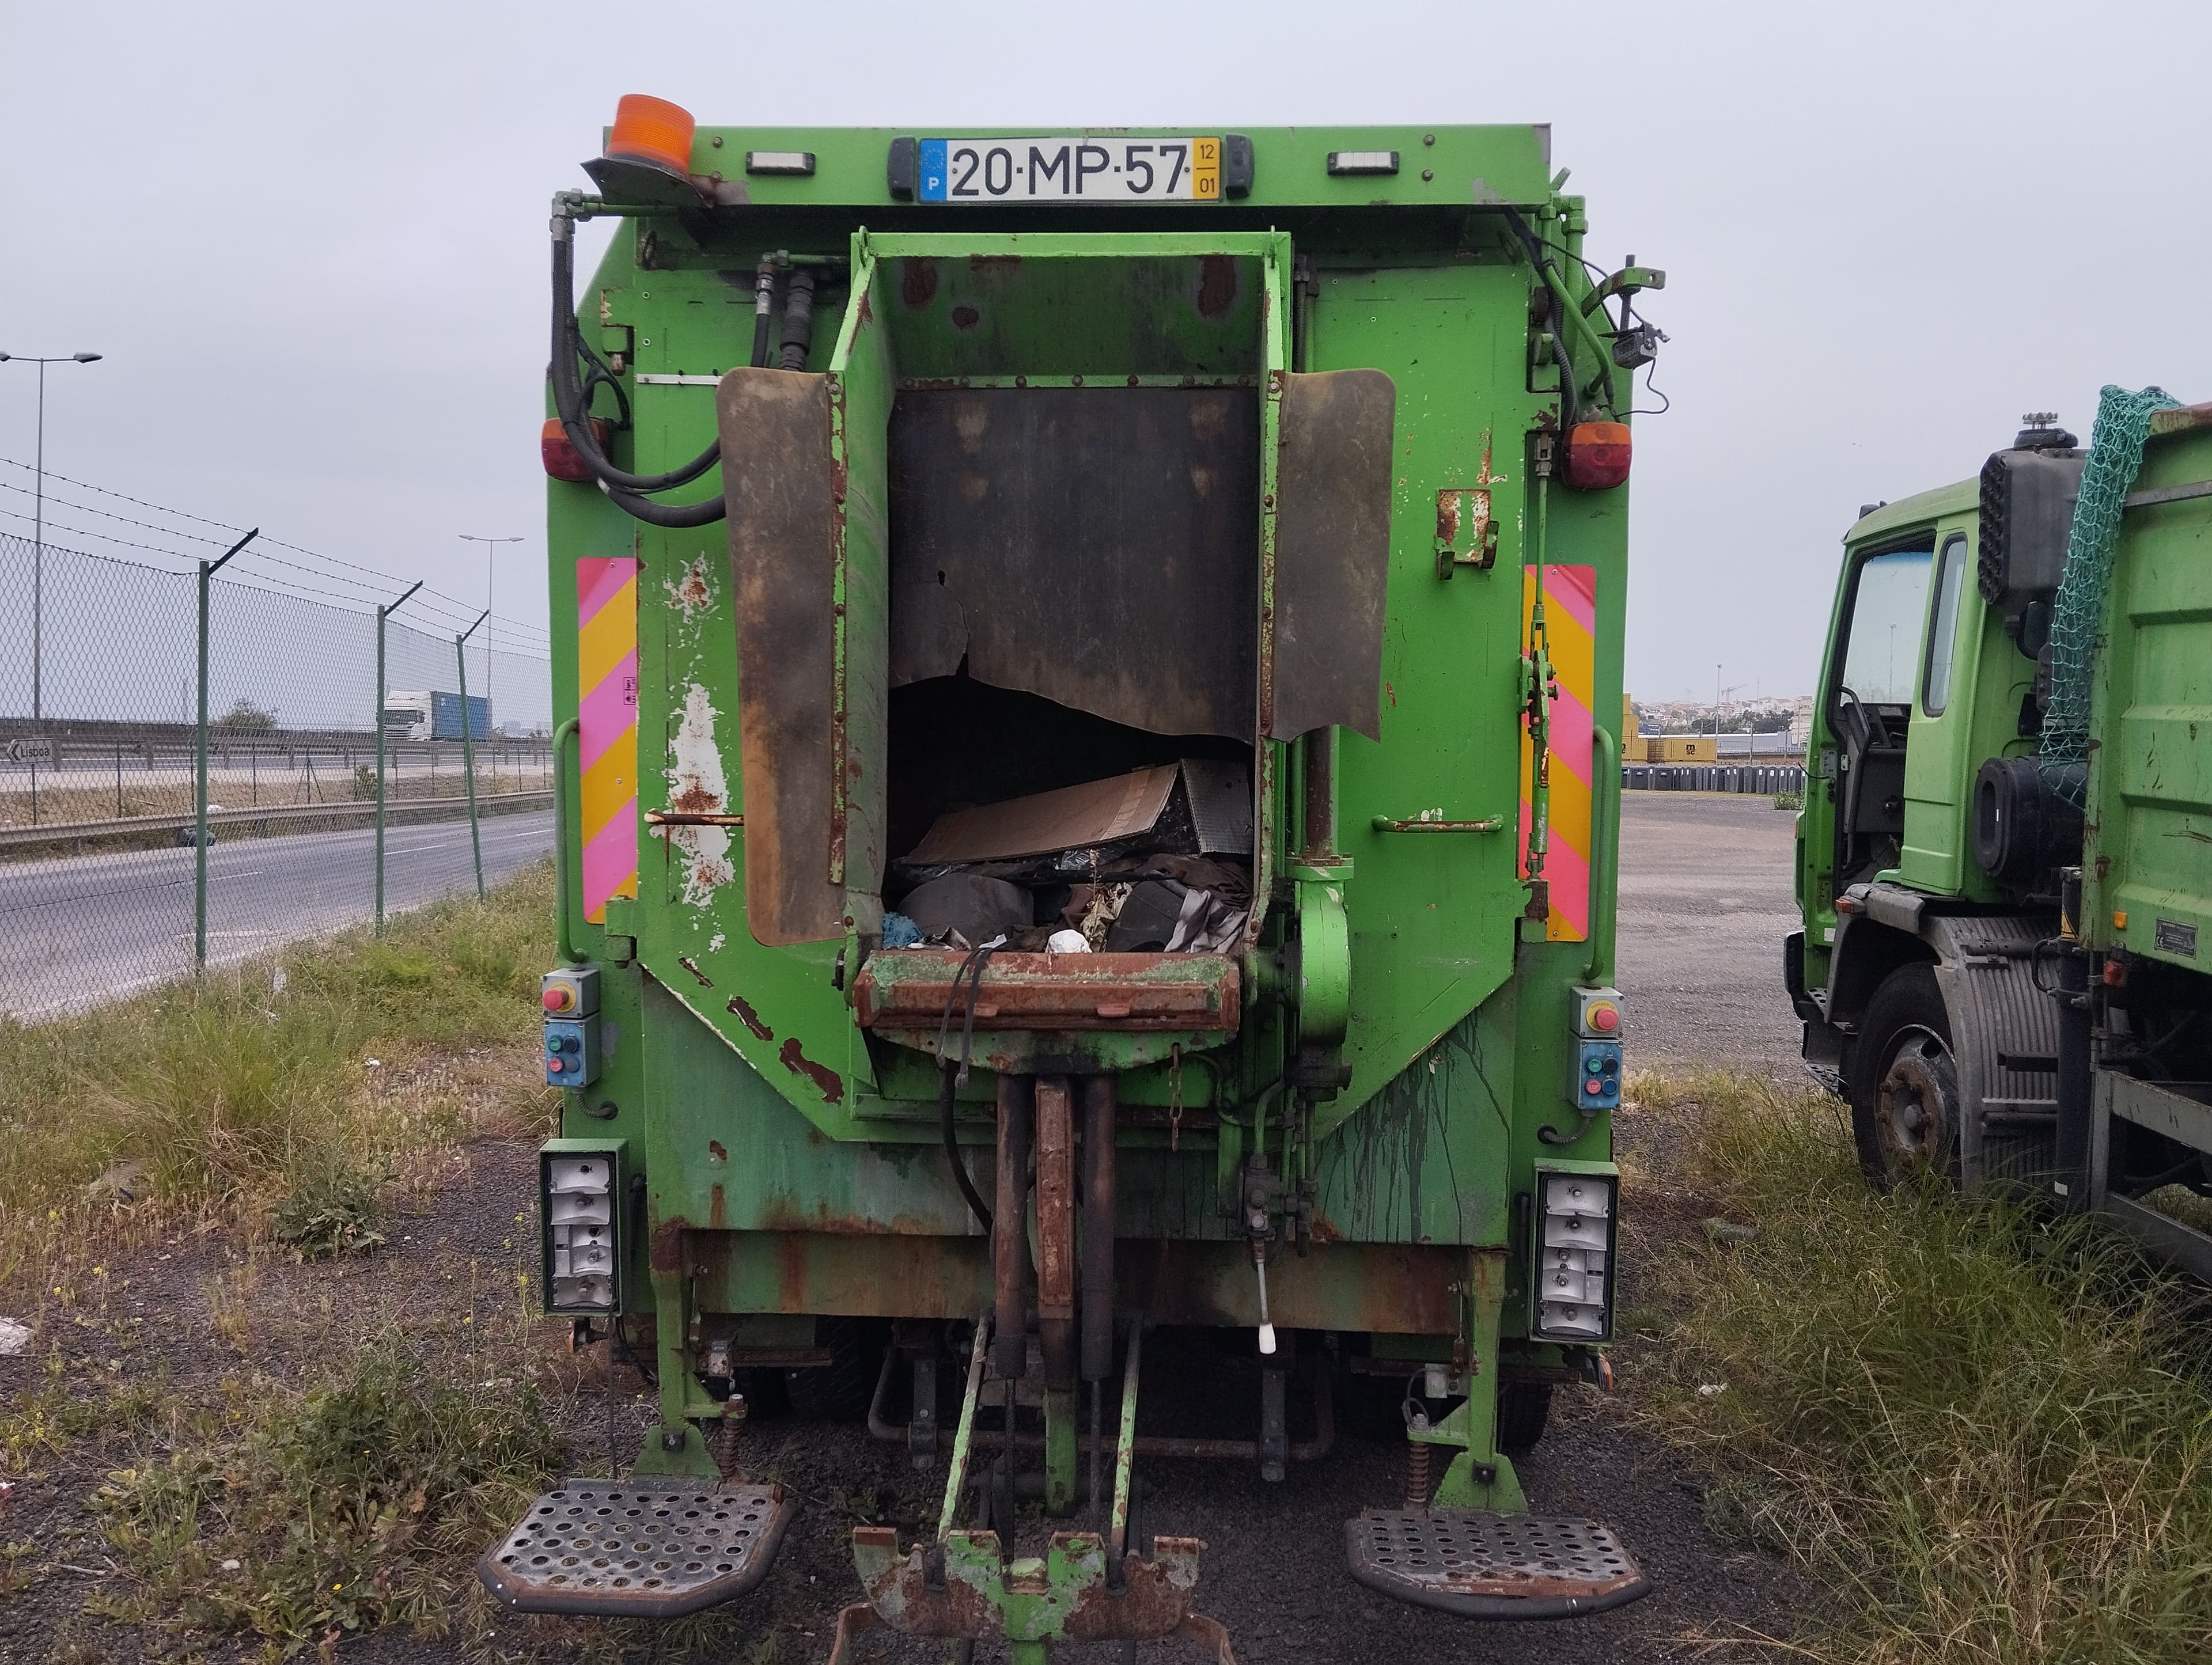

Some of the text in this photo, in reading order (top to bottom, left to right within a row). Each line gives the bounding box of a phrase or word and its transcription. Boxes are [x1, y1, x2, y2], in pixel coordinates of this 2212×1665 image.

[1200, 145, 1214, 159] 12
[928, 177, 939, 189] P
[1200, 179, 1215, 193] 01
[21, 746, 50, 757] Lisboa
